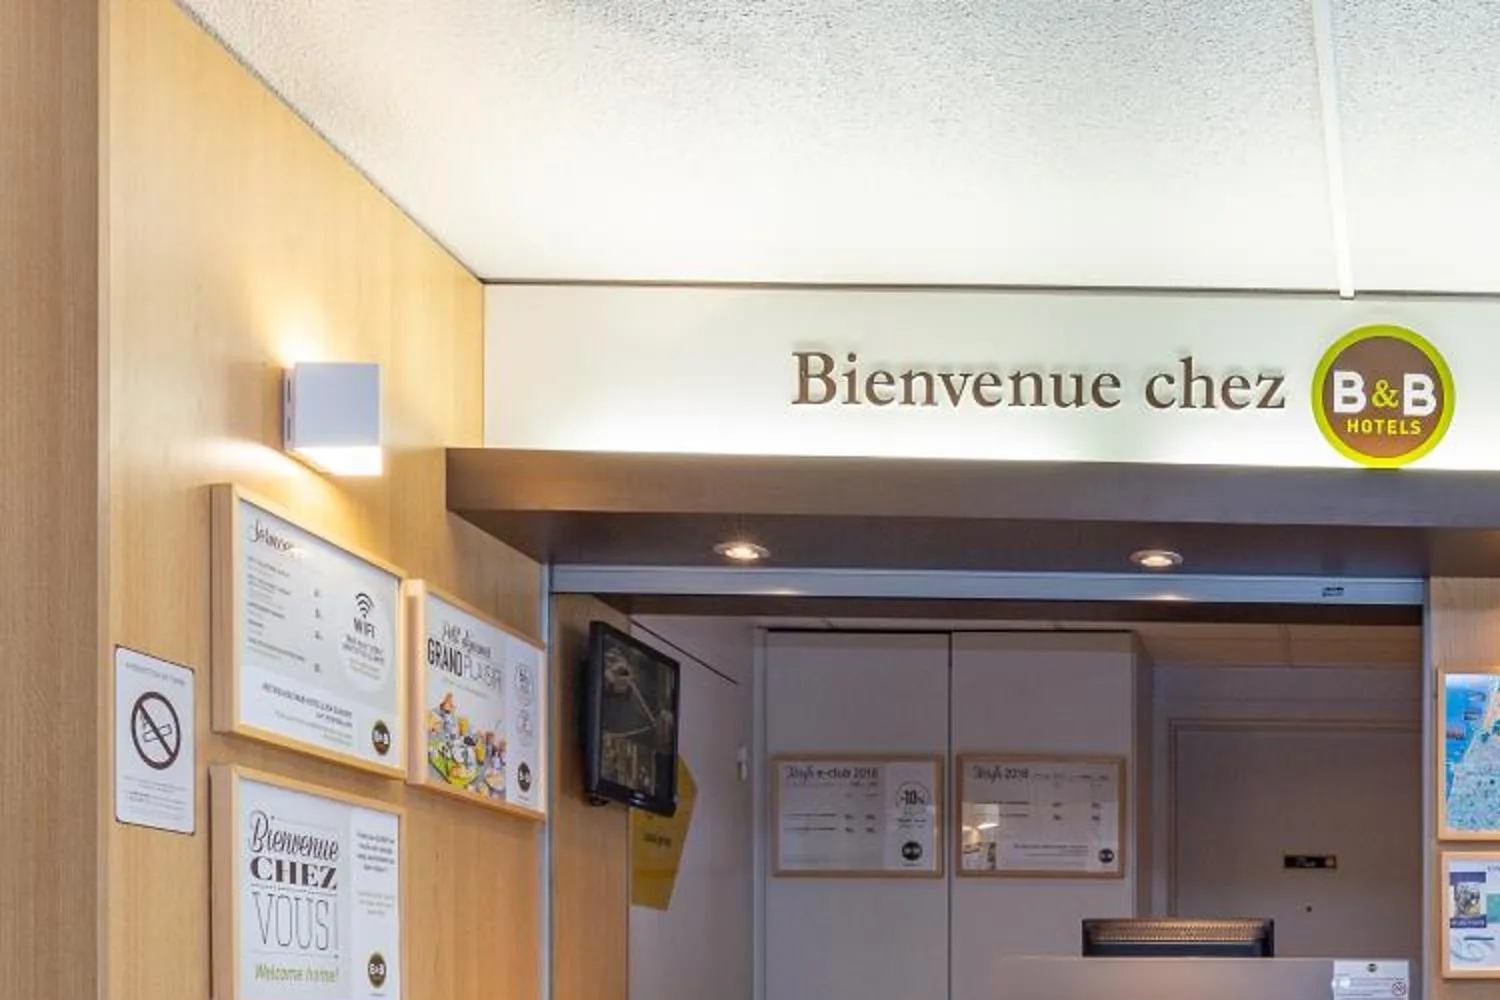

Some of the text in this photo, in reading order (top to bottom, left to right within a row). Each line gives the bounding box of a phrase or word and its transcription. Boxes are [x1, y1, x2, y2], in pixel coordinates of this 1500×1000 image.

[791, 351, 1287, 411] Bienvenue chez
[1333, 371, 1437, 417] B&B
[1347, 419, 1421, 435] HOTELS
[427, 637, 463, 678] GRAND
[249, 810, 339, 862] Bienvenue
[250, 856, 338, 890] CHEZ
[254, 962, 303, 982] Welcome
